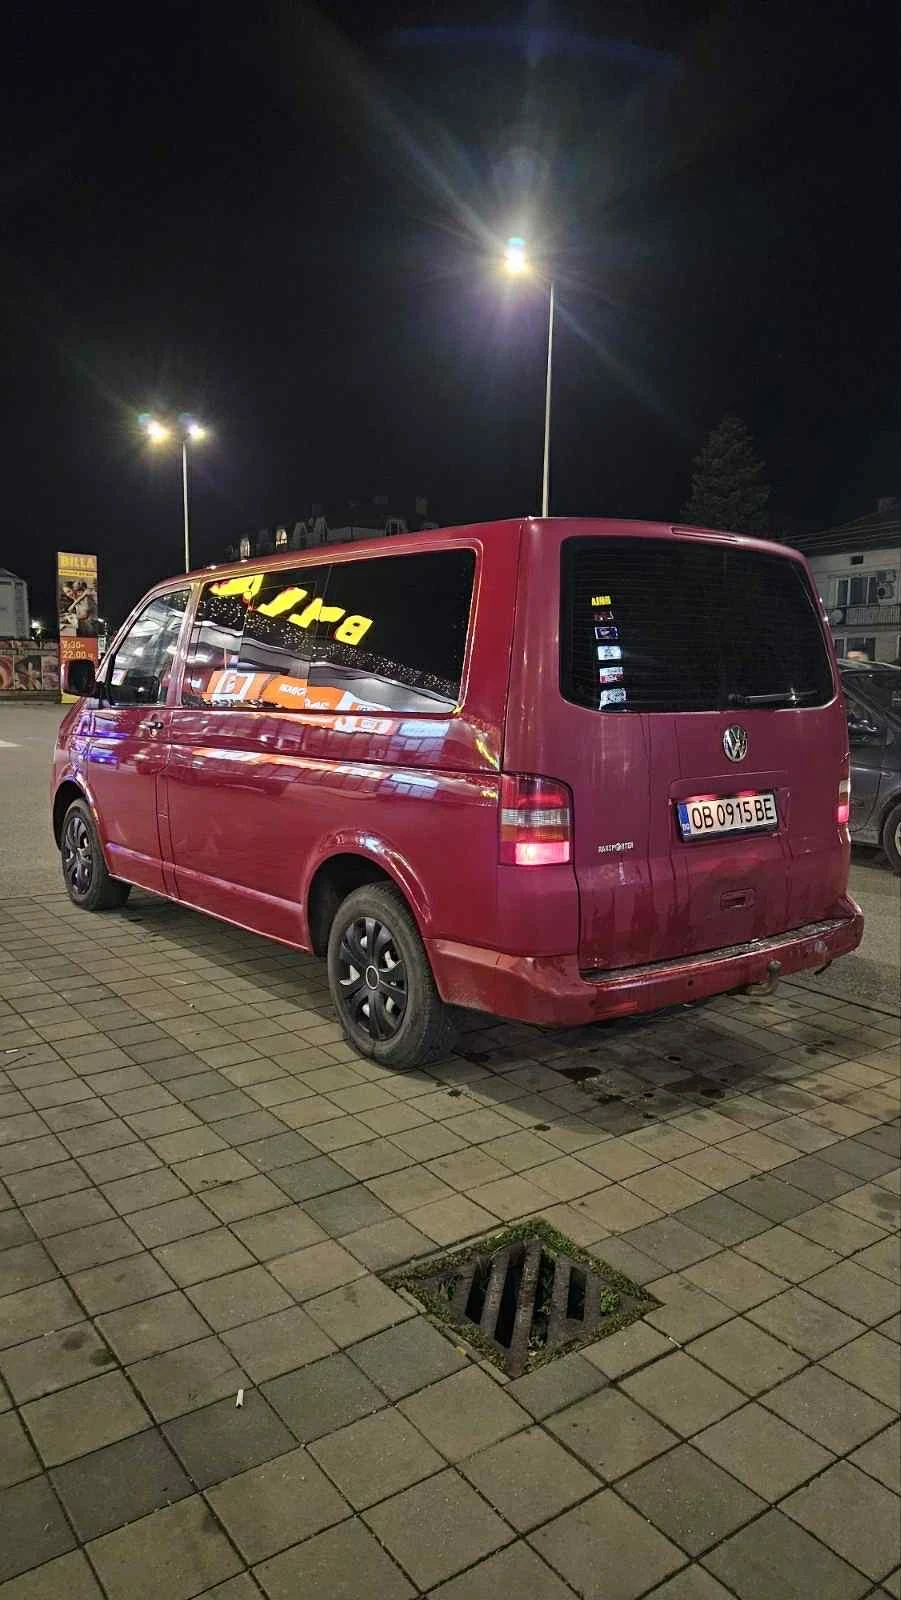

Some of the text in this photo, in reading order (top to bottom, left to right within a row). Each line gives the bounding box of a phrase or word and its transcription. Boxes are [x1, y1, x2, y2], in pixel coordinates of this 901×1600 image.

[692, 798, 774, 829] OB 0915 BE
